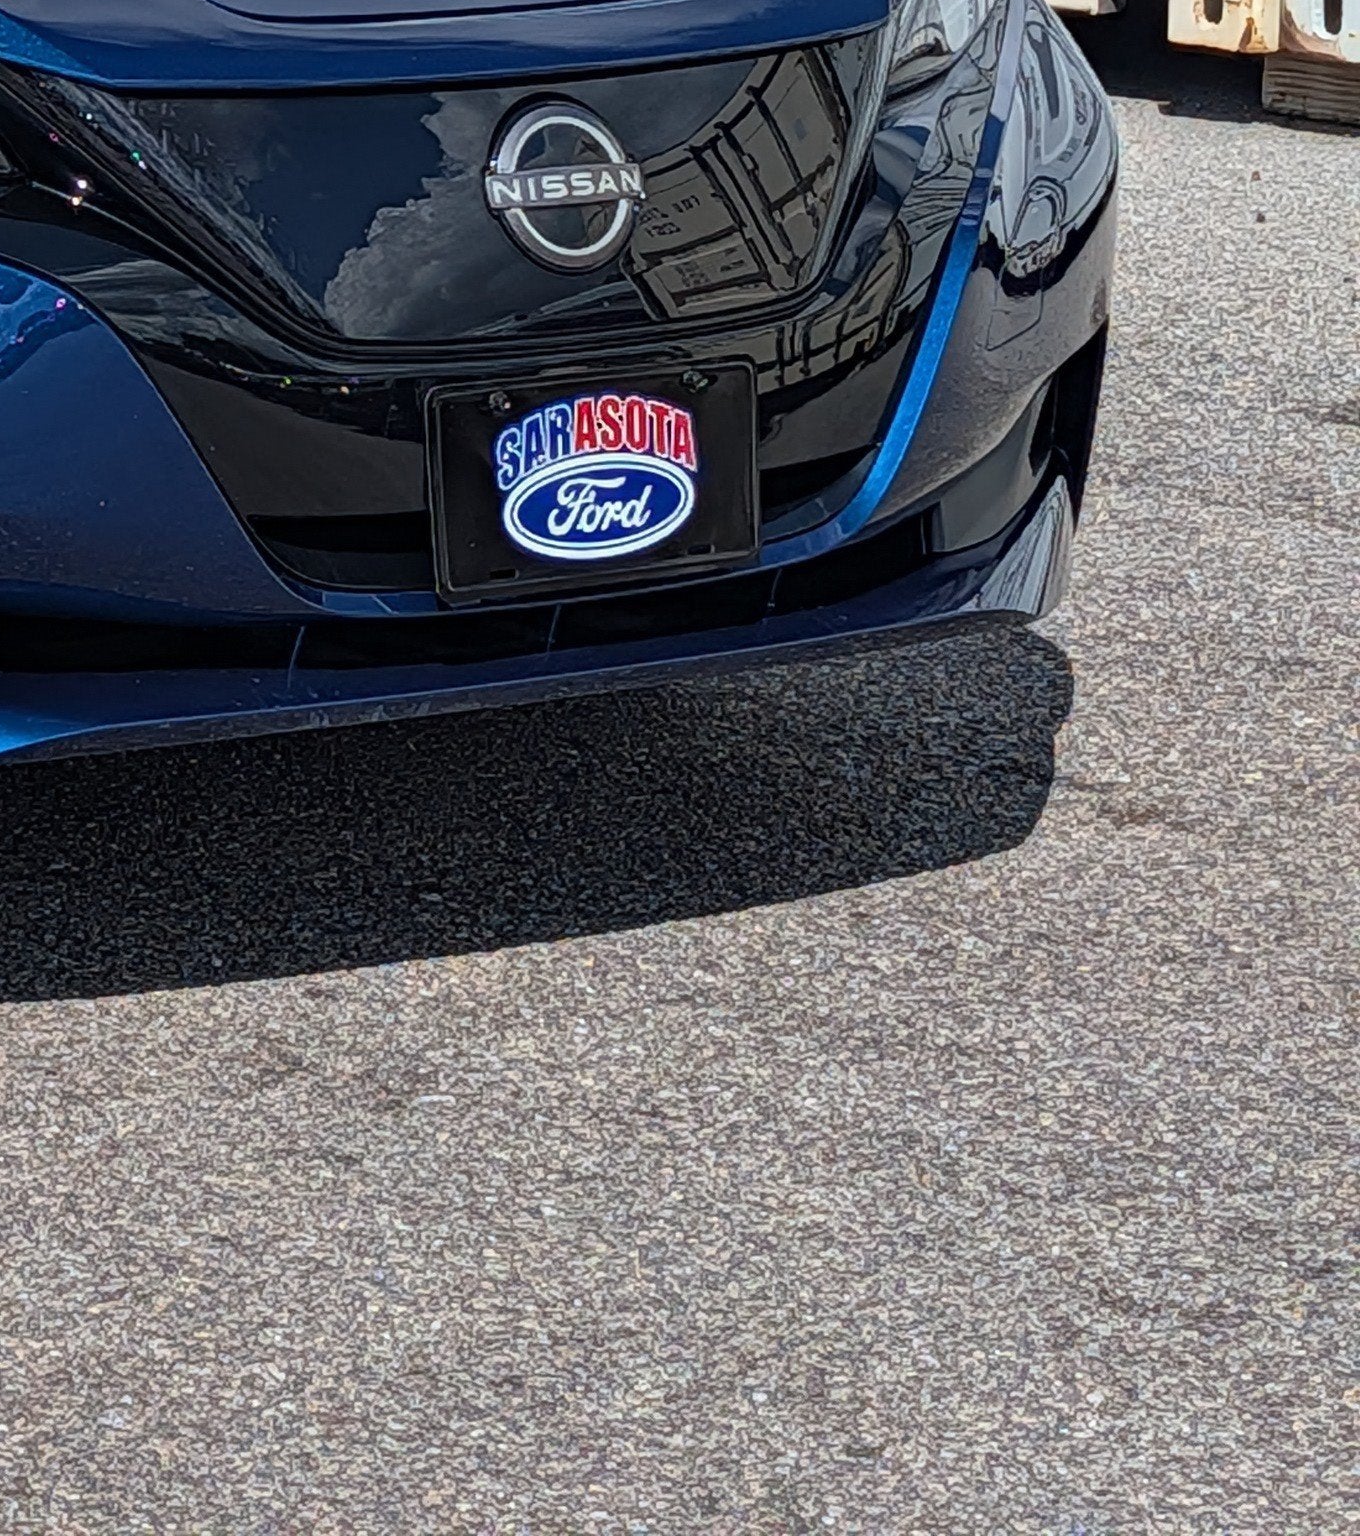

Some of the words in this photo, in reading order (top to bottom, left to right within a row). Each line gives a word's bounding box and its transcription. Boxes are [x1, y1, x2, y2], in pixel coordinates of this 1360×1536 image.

[491, 169, 643, 205] NISSAN
[495, 394, 699, 492] SARASOTA
[546, 475, 654, 537] Ford
